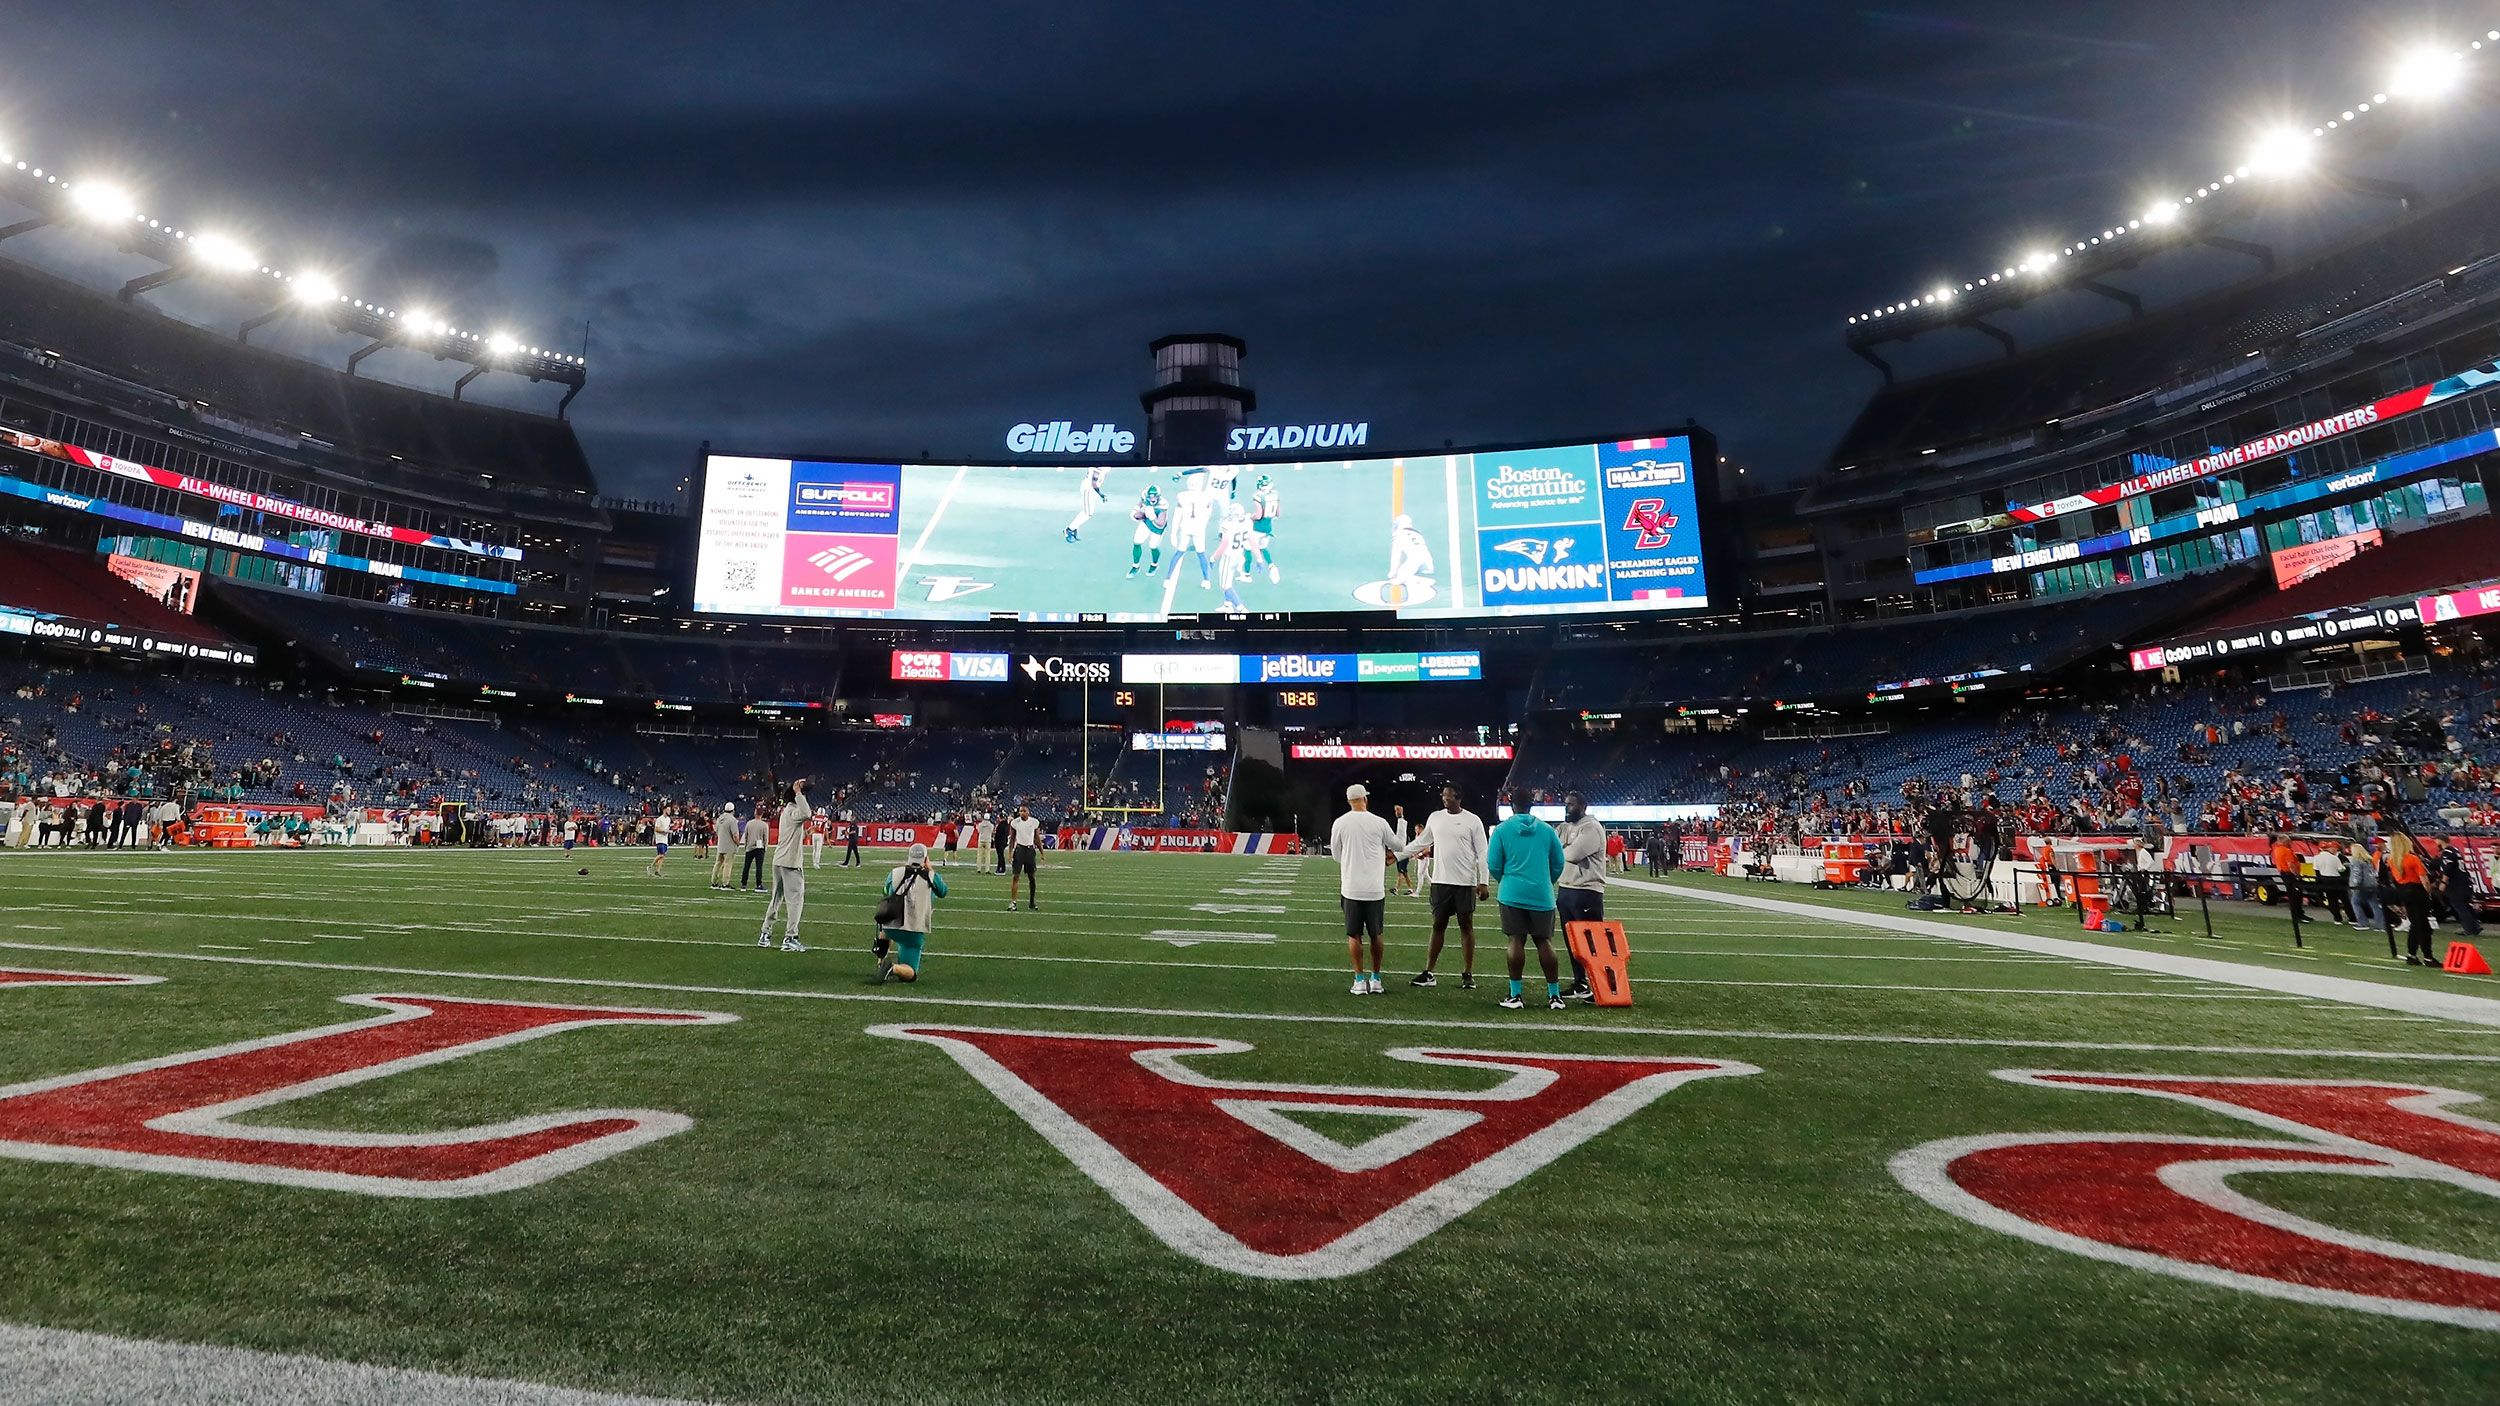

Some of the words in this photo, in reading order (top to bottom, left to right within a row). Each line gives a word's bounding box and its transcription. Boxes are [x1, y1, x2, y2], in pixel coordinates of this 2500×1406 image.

[1006, 421, 1135, 453] Gillette
[1226, 422, 1368, 450] STADIUM
[2119, 462, 2198, 498] ALL-WHEEL
[2200, 448, 2243, 474] DRIVE
[2244, 405, 2378, 460] HEADQUARTERS
[115, 462, 141, 475] TOYOTA
[1499, 466, 1560, 484] Boston
[1612, 468, 1680, 483] HALFTIME
[1487, 472, 1586, 499] Scientific
[2326, 472, 2374, 493] verizon
[47, 492, 89, 510] verizon
[178, 477, 252, 507] ALL-WHEEL
[256, 497, 293, 518] DRIVE
[802, 488, 885, 502] SUFFOLK
[1492, 500, 1529, 510] Advancing
[1531, 498, 1555, 507] science
[1556, 497, 1567, 506] for
[2057, 498, 2083, 511] TOYOTA
[2196, 503, 2239, 528] MIAMI
[182, 520, 209, 540] NEW
[210, 526, 264, 551] ENGLAND
[2128, 526, 2150, 545] VS
[308, 548, 326, 564] VS
[1992, 555, 2023, 573] NEW
[2023, 543, 2080, 568] ENGLAND
[2280, 553, 2296, 562] Facial
[2311, 547, 2324, 555] that
[2325, 544, 2340, 552] feels
[116, 558, 131, 567] Facial
[368, 560, 402, 578] MIAMI
[1610, 558, 1663, 570] SCREAMING
[1664, 556, 1699, 566] EAGLES
[2292, 558, 2307, 568] good
[1485, 563, 1603, 592] DUNKIN'
[1616, 568, 1666, 580] MARCHING
[1668, 566, 1695, 576] BAND
[791, 586, 820, 596] BANK
[822, 587, 836, 597] OF
[838, 588, 884, 598] AMERICA
[2480, 591, 2500, 609] NE
[34, 621, 64, 637] 0:00
[91, 630, 101, 643] 0
[143, 638, 152, 650] 0
[189, 645, 198, 657] 0
[233, 652, 242, 664] 0
[2148, 650, 2162, 666] NE
[2165, 646, 2192, 664] 0:00
[2216, 640, 2228, 654] 0
[2271, 630, 2283, 645] 0
[2325, 621, 2338, 636] 0
[2385, 609, 2398, 625] 0
[913, 654, 942, 666] CVS
[953, 658, 1004, 677] VISA
[1045, 657, 1109, 678] CROSS
[1260, 655, 1335, 683] jetBlue
[1374, 664, 1417, 674] paycom
[1430, 667, 1469, 677] COMPANIES
[1116, 692, 1132, 706] 25
[1280, 692, 1316, 705] 78:26
[1776, 702, 1814, 711] RAFTKINGS
[1298, 746, 1347, 758] TOYOTA
[1350, 746, 1400, 758] TOYOTA
[1404, 746, 1453, 758] TOYOTA
[1457, 746, 1508, 758] TOYOTA
[877, 828, 915, 842] 1960
[1160, 836, 1217, 847] ENGLAND
[2449, 946, 2466, 968] 10
